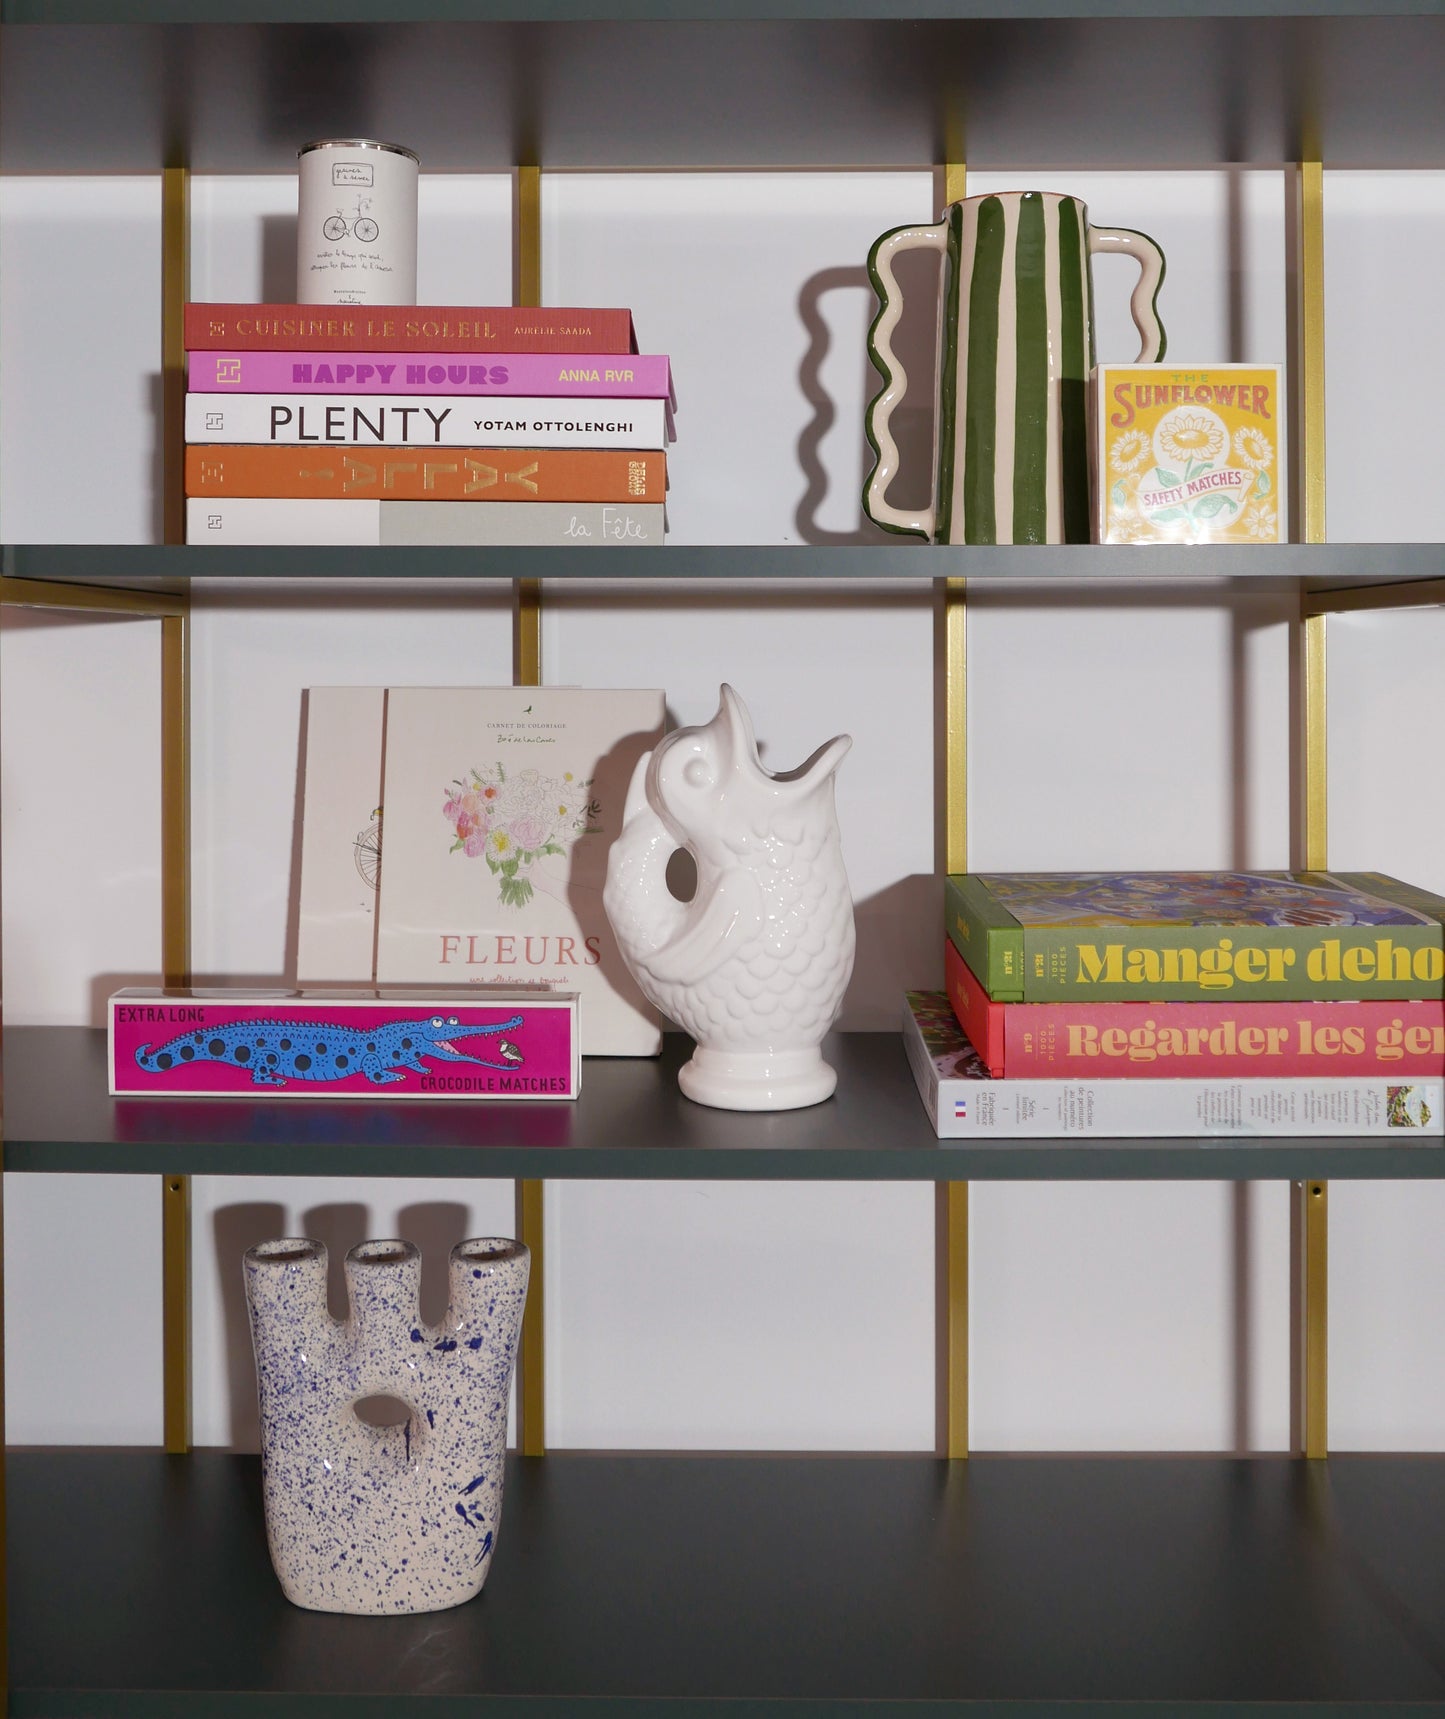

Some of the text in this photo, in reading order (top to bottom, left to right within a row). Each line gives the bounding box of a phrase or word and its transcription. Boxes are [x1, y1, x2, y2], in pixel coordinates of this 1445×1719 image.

[236, 319, 497, 339] CUISINER LE SOLEIL
[559, 327, 593, 337] SAADA
[292, 363, 509, 385] HAPPY HOURS
[558, 369, 634, 383] ANNA RVR
[1171, 374, 1209, 383] THE
[1111, 383, 1272, 429] SUNFLOWER
[269, 405, 452, 442] PLENTY
[474, 419, 634, 433] YOTAM OTTOLENGHI
[1143, 471, 1242, 507] SAFETY MATCHES
[563, 507, 648, 540] la Fête
[439, 935, 601, 966] FLEURS
[1075, 938, 1296, 990] Manger
[118, 1007, 205, 1023] EXTRA LONG
[1039, 1030, 1047, 1055] 1000
[1065, 1019, 1289, 1063] Regarder
[1299, 1020, 1366, 1055] les
[420, 1077, 566, 1092] CROCODILE MATCHES
[987, 1092, 996, 1126] Fabriquée
[1086, 1090, 1094, 1127] Collection
